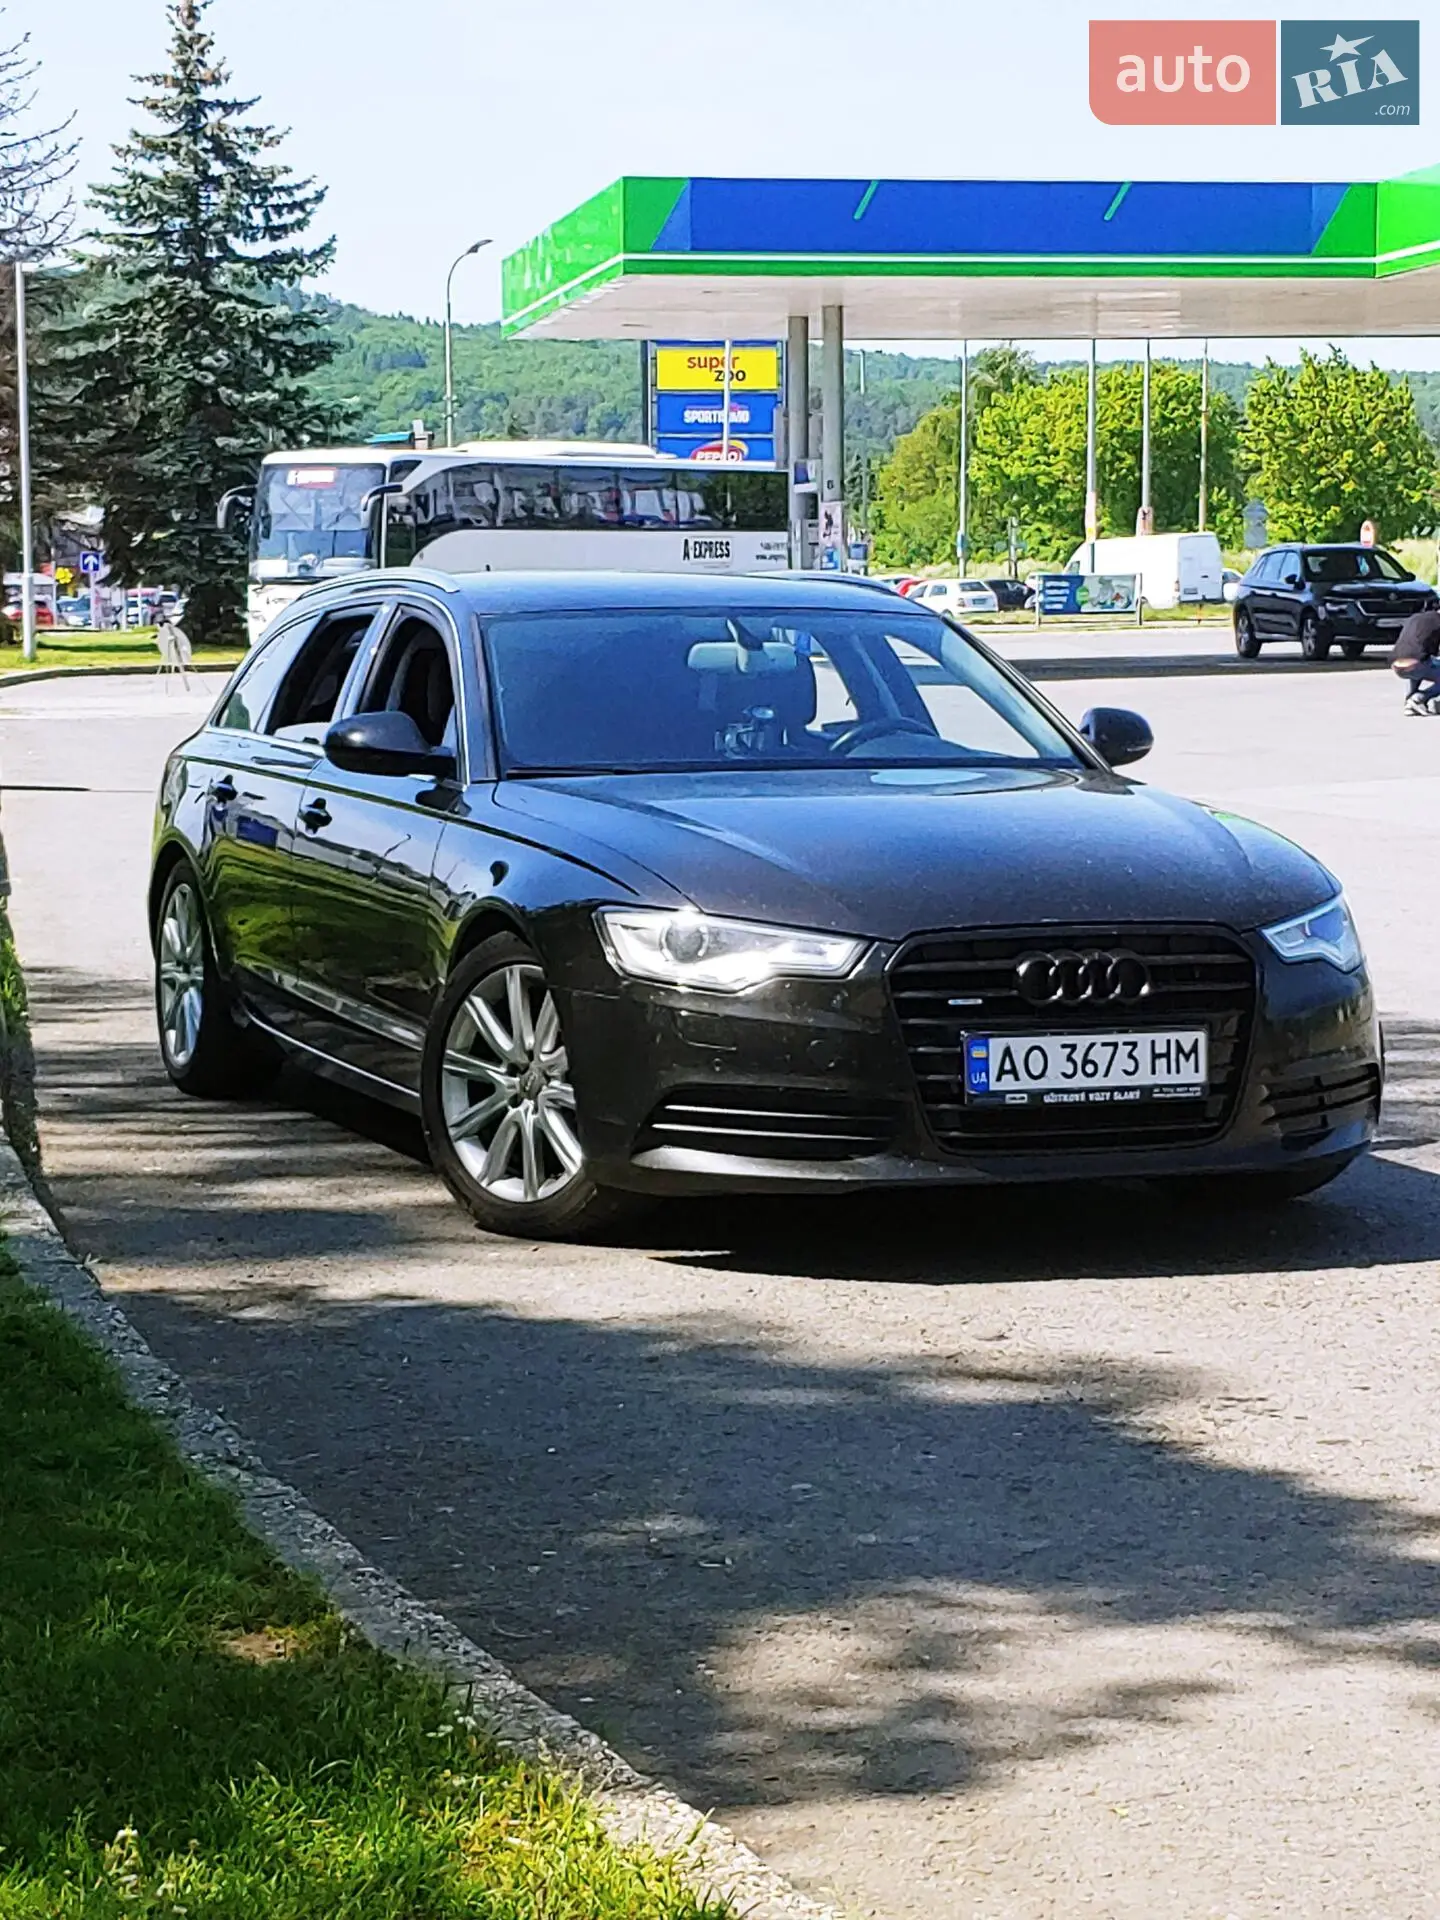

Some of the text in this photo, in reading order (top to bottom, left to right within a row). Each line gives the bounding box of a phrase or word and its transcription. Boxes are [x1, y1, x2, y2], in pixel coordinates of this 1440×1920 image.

[684, 410, 750, 423] SPORTIMO
[995, 1038, 1200, 1083] AO 3673 HM
[971, 1072, 988, 1084] UA
